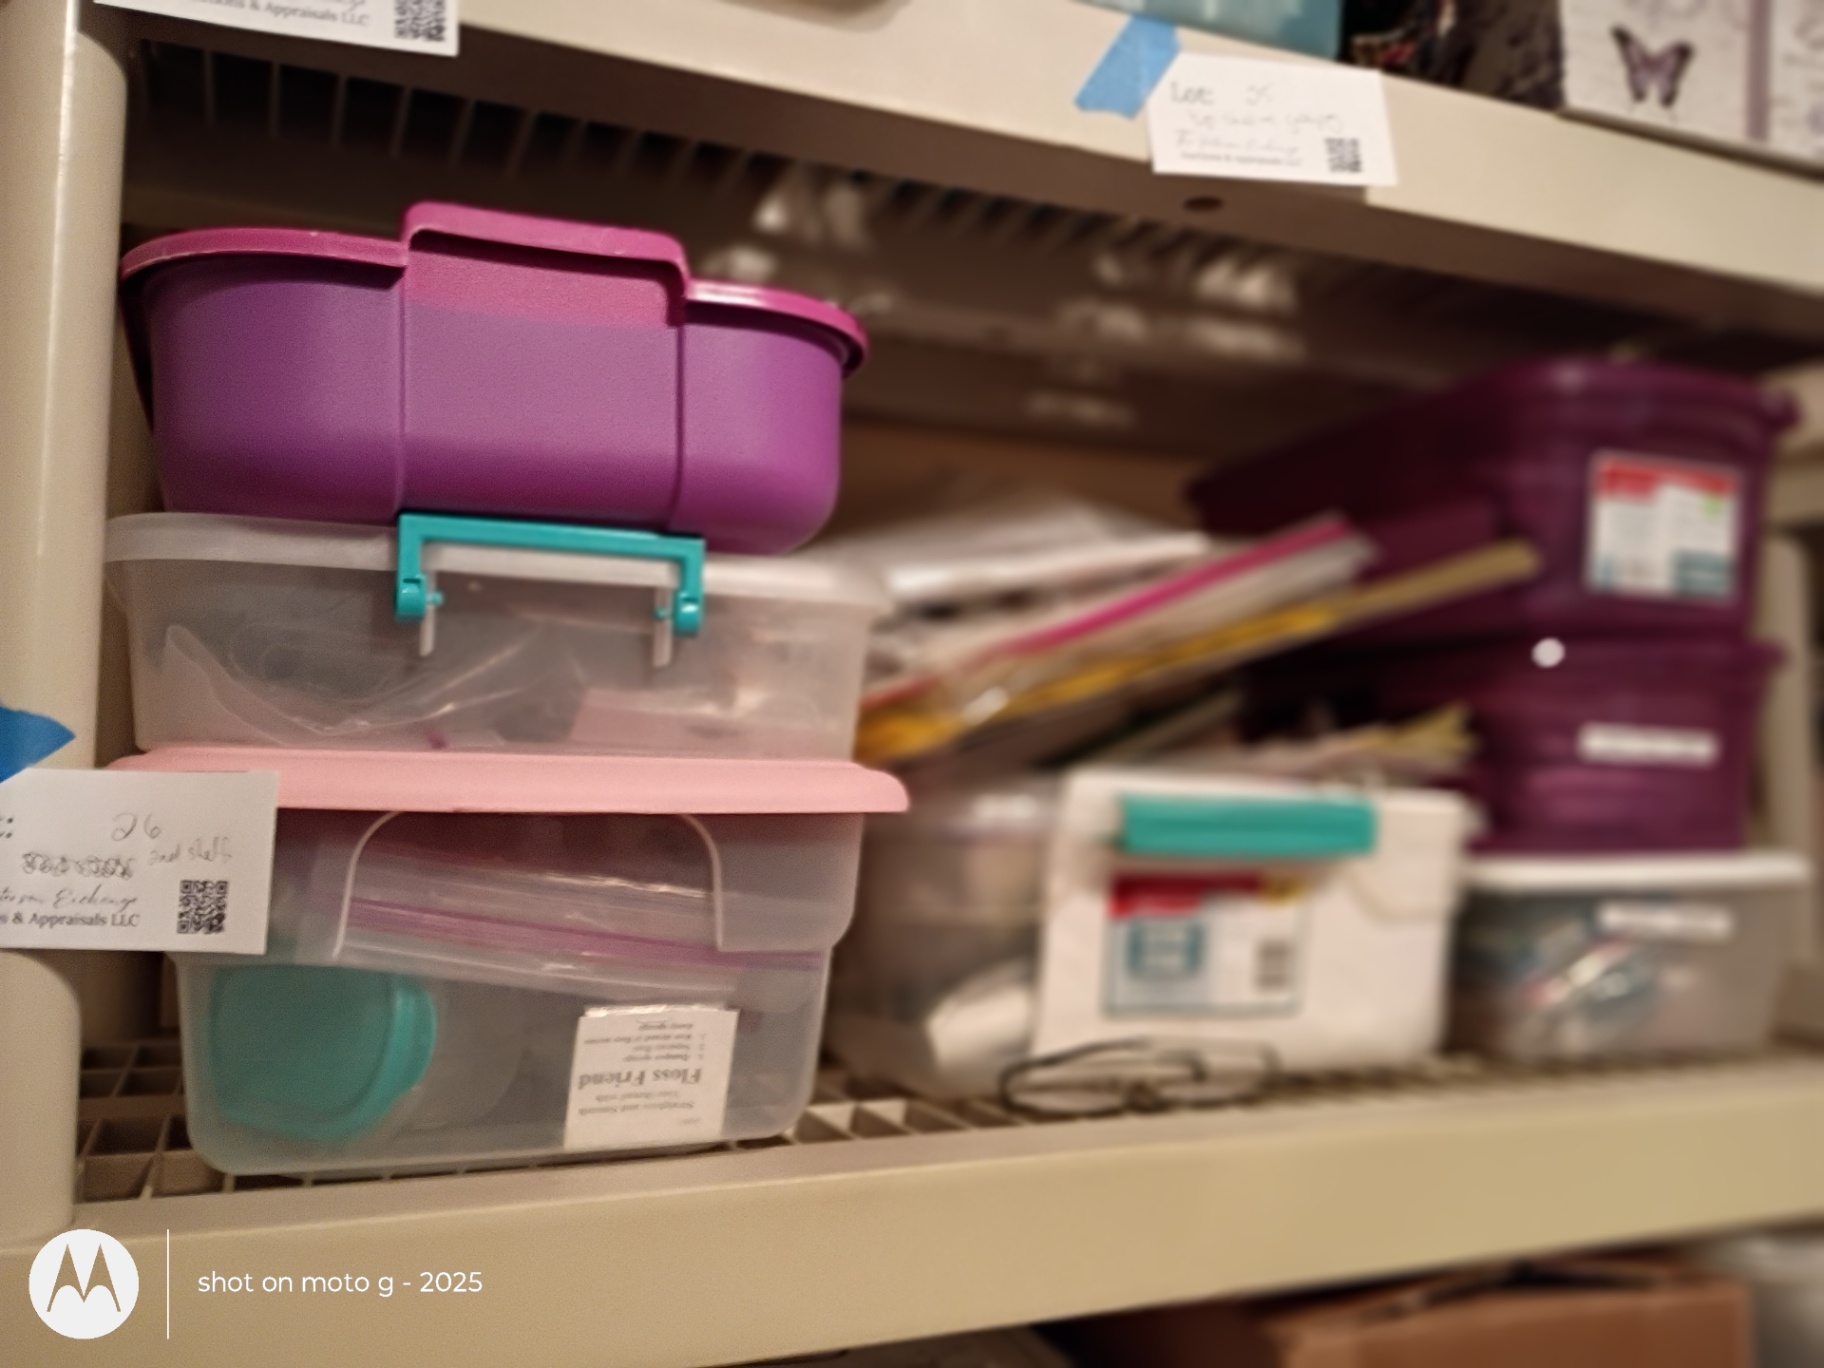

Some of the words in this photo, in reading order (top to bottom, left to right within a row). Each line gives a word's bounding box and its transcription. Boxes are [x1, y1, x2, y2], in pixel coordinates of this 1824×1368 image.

[249, 0, 260, 11] &
[264, 3, 339, 22] Appraisals
[341, 11, 370, 26] LLC
[111, 813, 162, 842] 26
[12, 912, 22, 924] &
[29, 912, 107, 929] Appraisals
[110, 913, 140, 927] LLC
[578, 1069, 646, 1091] Friend
[652, 1068, 702, 1085] Floss
